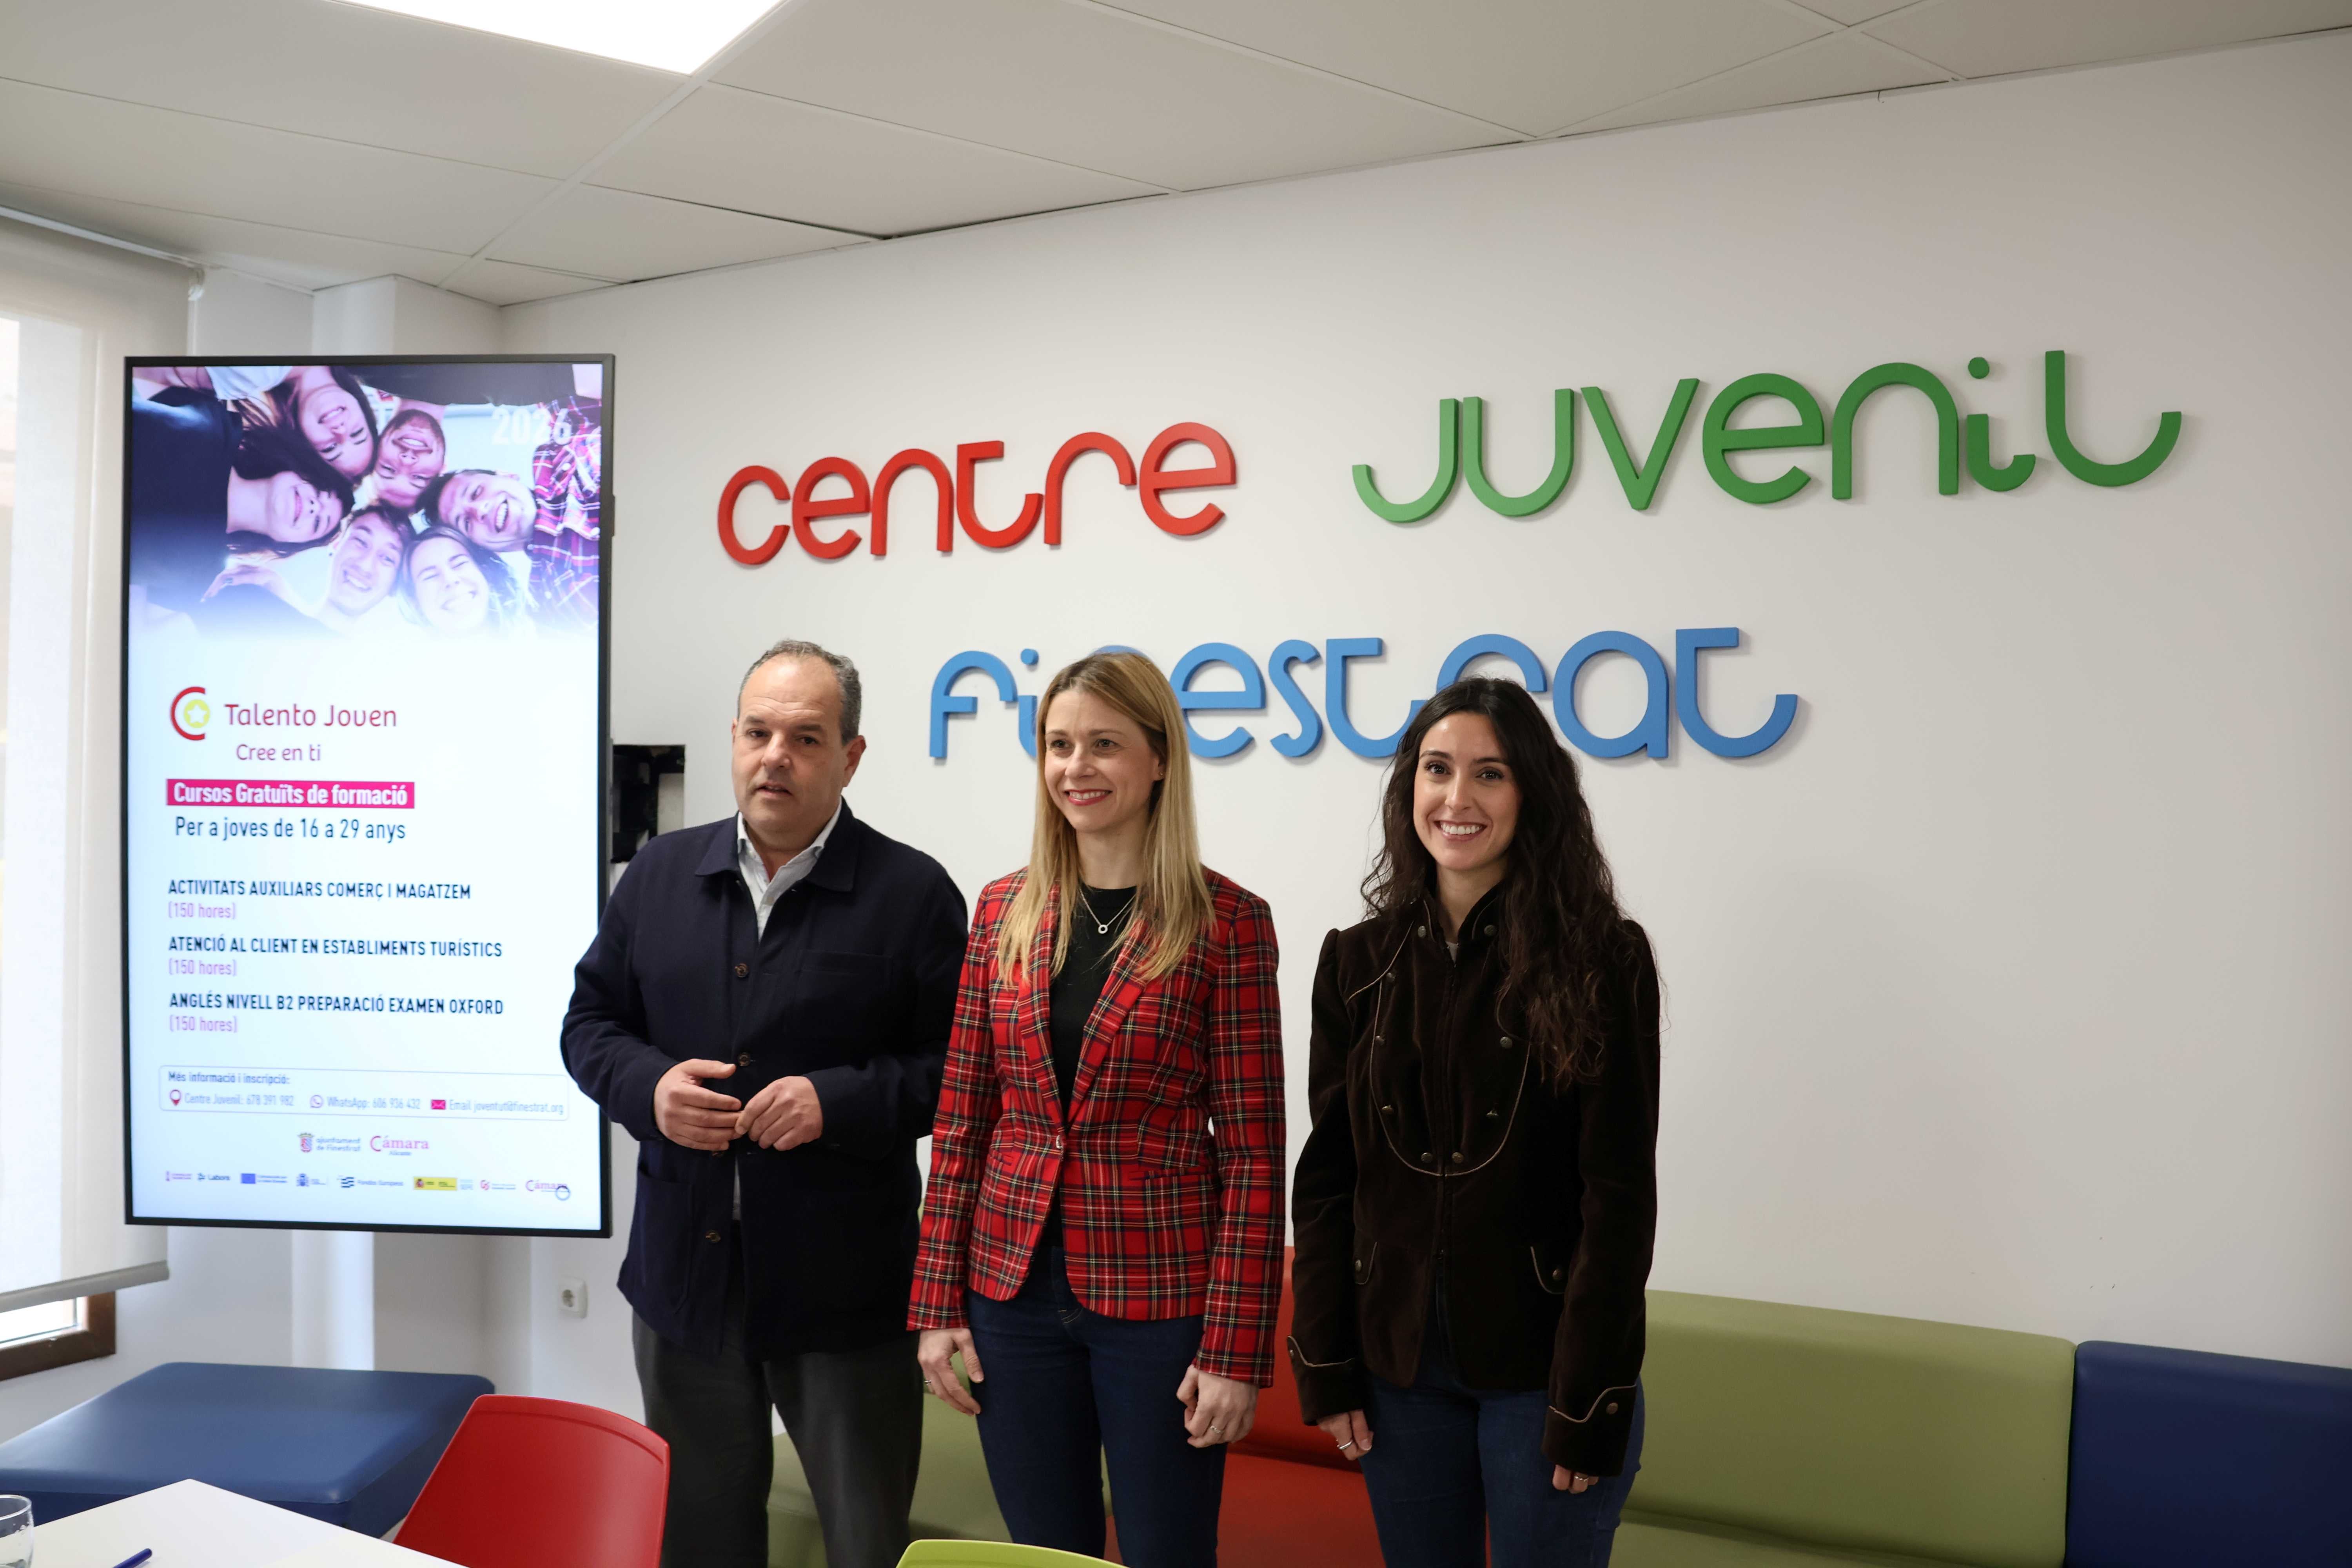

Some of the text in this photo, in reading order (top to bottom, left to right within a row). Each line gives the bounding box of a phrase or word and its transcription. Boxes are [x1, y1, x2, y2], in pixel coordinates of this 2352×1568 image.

[492, 408, 572, 445] 2026
[930, 628, 1797, 758] fiestrat
[224, 703, 396, 727] Talento Joven
[236, 744, 320, 761] Cree en ti
[174, 782, 408, 805] Cursos Gratuïts de formació
[176, 817, 405, 843] Per a joves de 16 a 29 anys
[169, 880, 470, 901] ACTIVITATS AUXILIARS COMERÇ I MAGATZEM
[169, 901, 235, 919] (150 hores)
[169, 935, 502, 956] ATENCIÓ AL CLIENT EN ESTABLIMENTS TURÍSTICS
[169, 958, 236, 976] (150 hores)
[170, 990, 503, 1014] ANGLÉS NIVELL B2 PREPARACIÓ EXAMEN OXFORD
[170, 1014, 237, 1033] (150 hores)
[169, 1072, 186, 1081] Més
[189, 1072, 235, 1083] informació
[185, 1093, 210, 1104] Centre
[370, 1135, 428, 1151] Cámara
